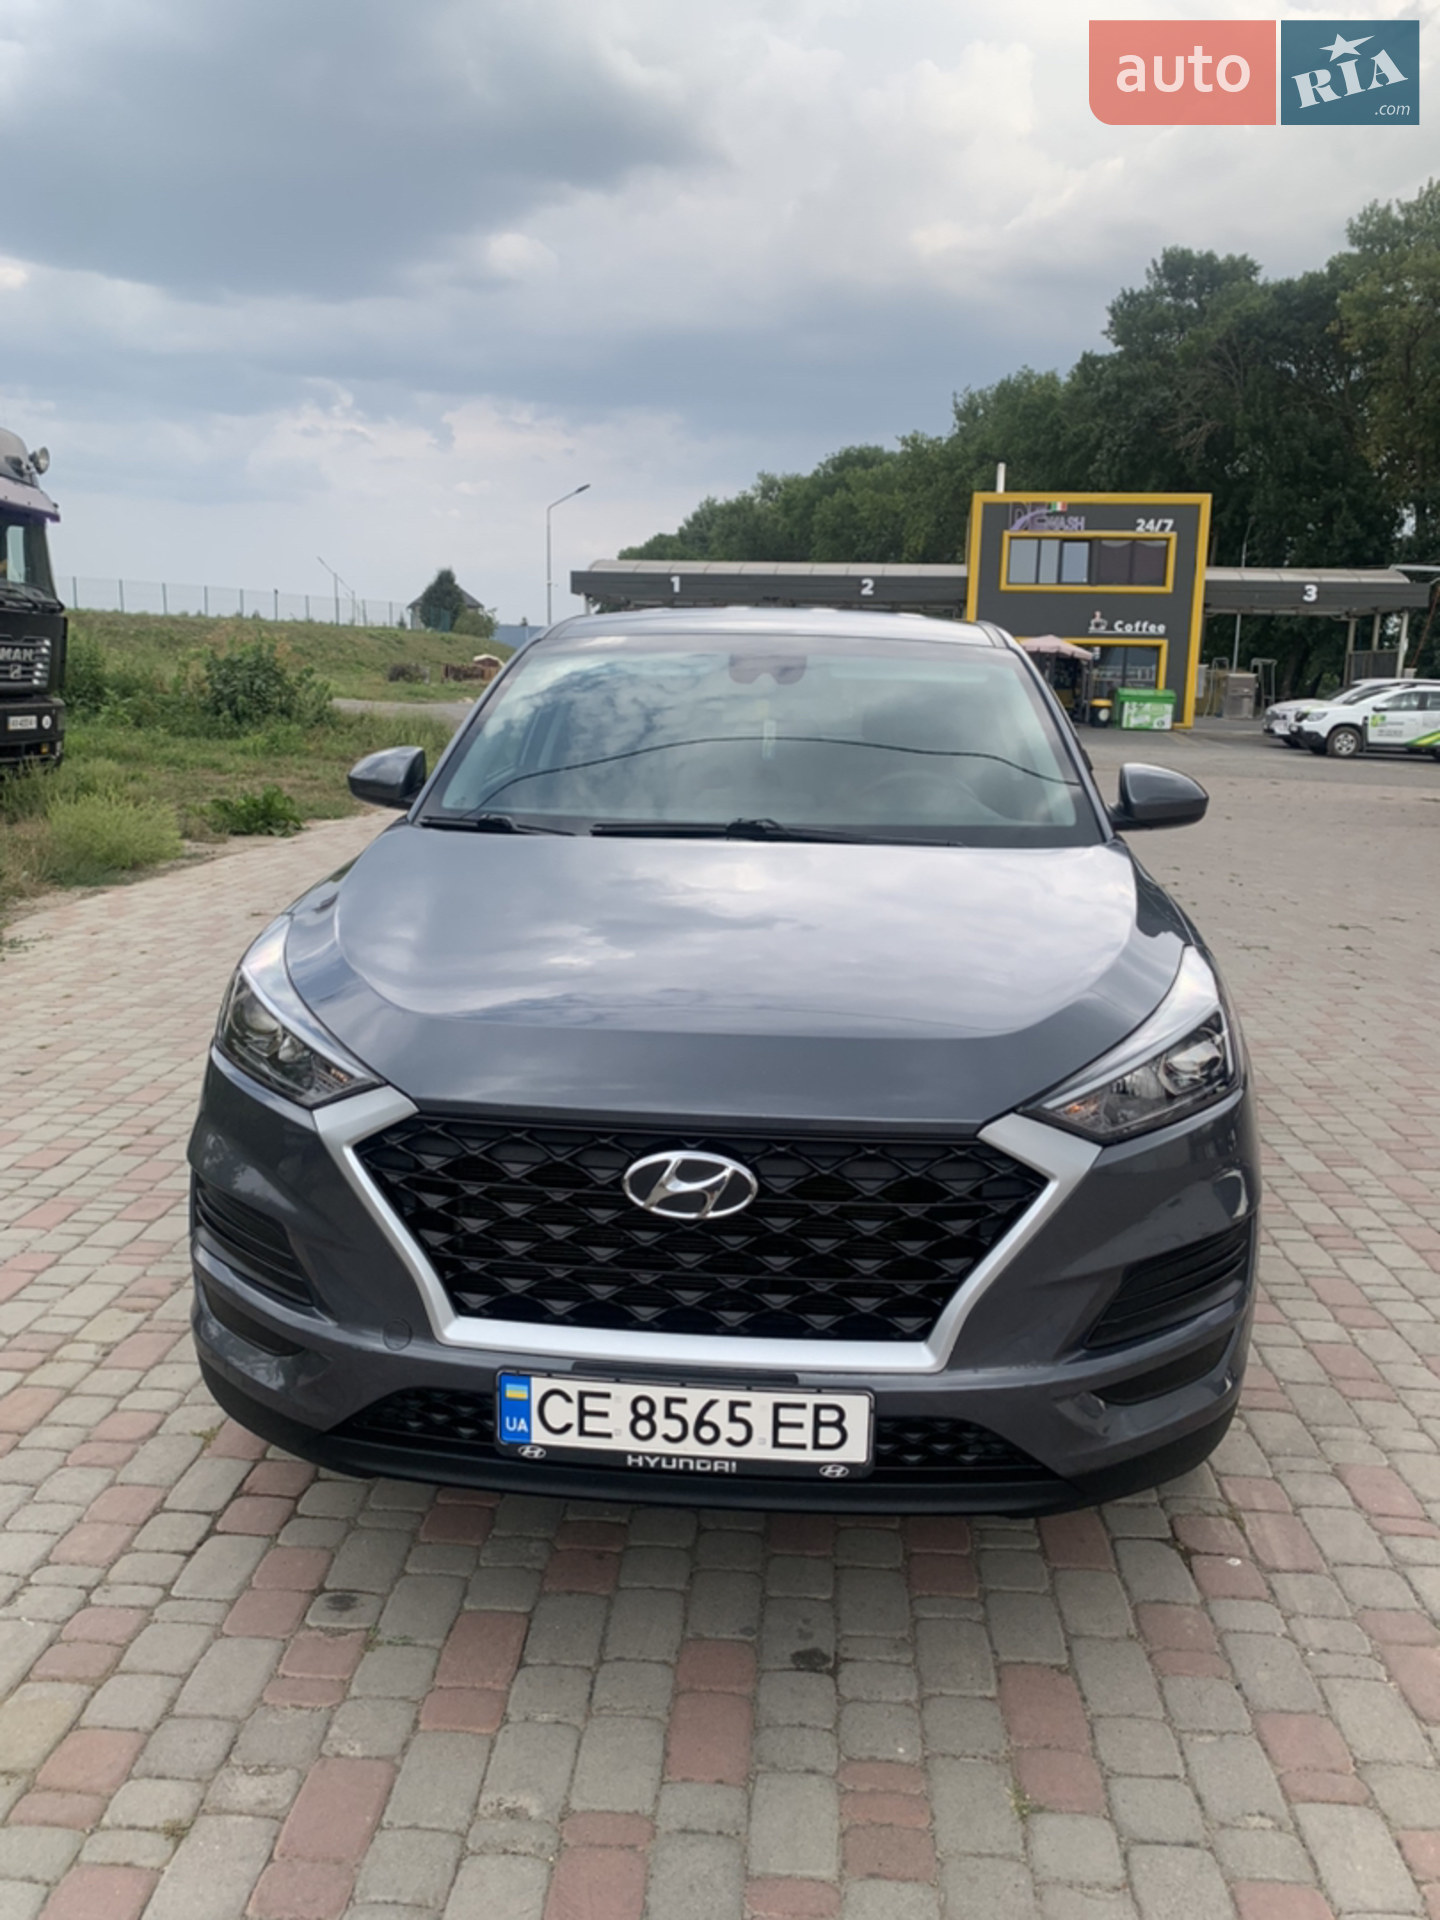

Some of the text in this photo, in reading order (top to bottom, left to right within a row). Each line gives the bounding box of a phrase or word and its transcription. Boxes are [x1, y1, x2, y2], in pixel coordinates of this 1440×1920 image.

[1135, 518, 1174, 532] 24/7
[670, 576, 681, 592] 1
[861, 578, 874, 595] 2
[1302, 584, 1318, 601] 3
[1114, 620, 1166, 633] Coffee
[505, 1415, 528, 1433] UA
[537, 1388, 848, 1451] CE 8565 EB
[626, 1453, 737, 1474] HYUNDAI
